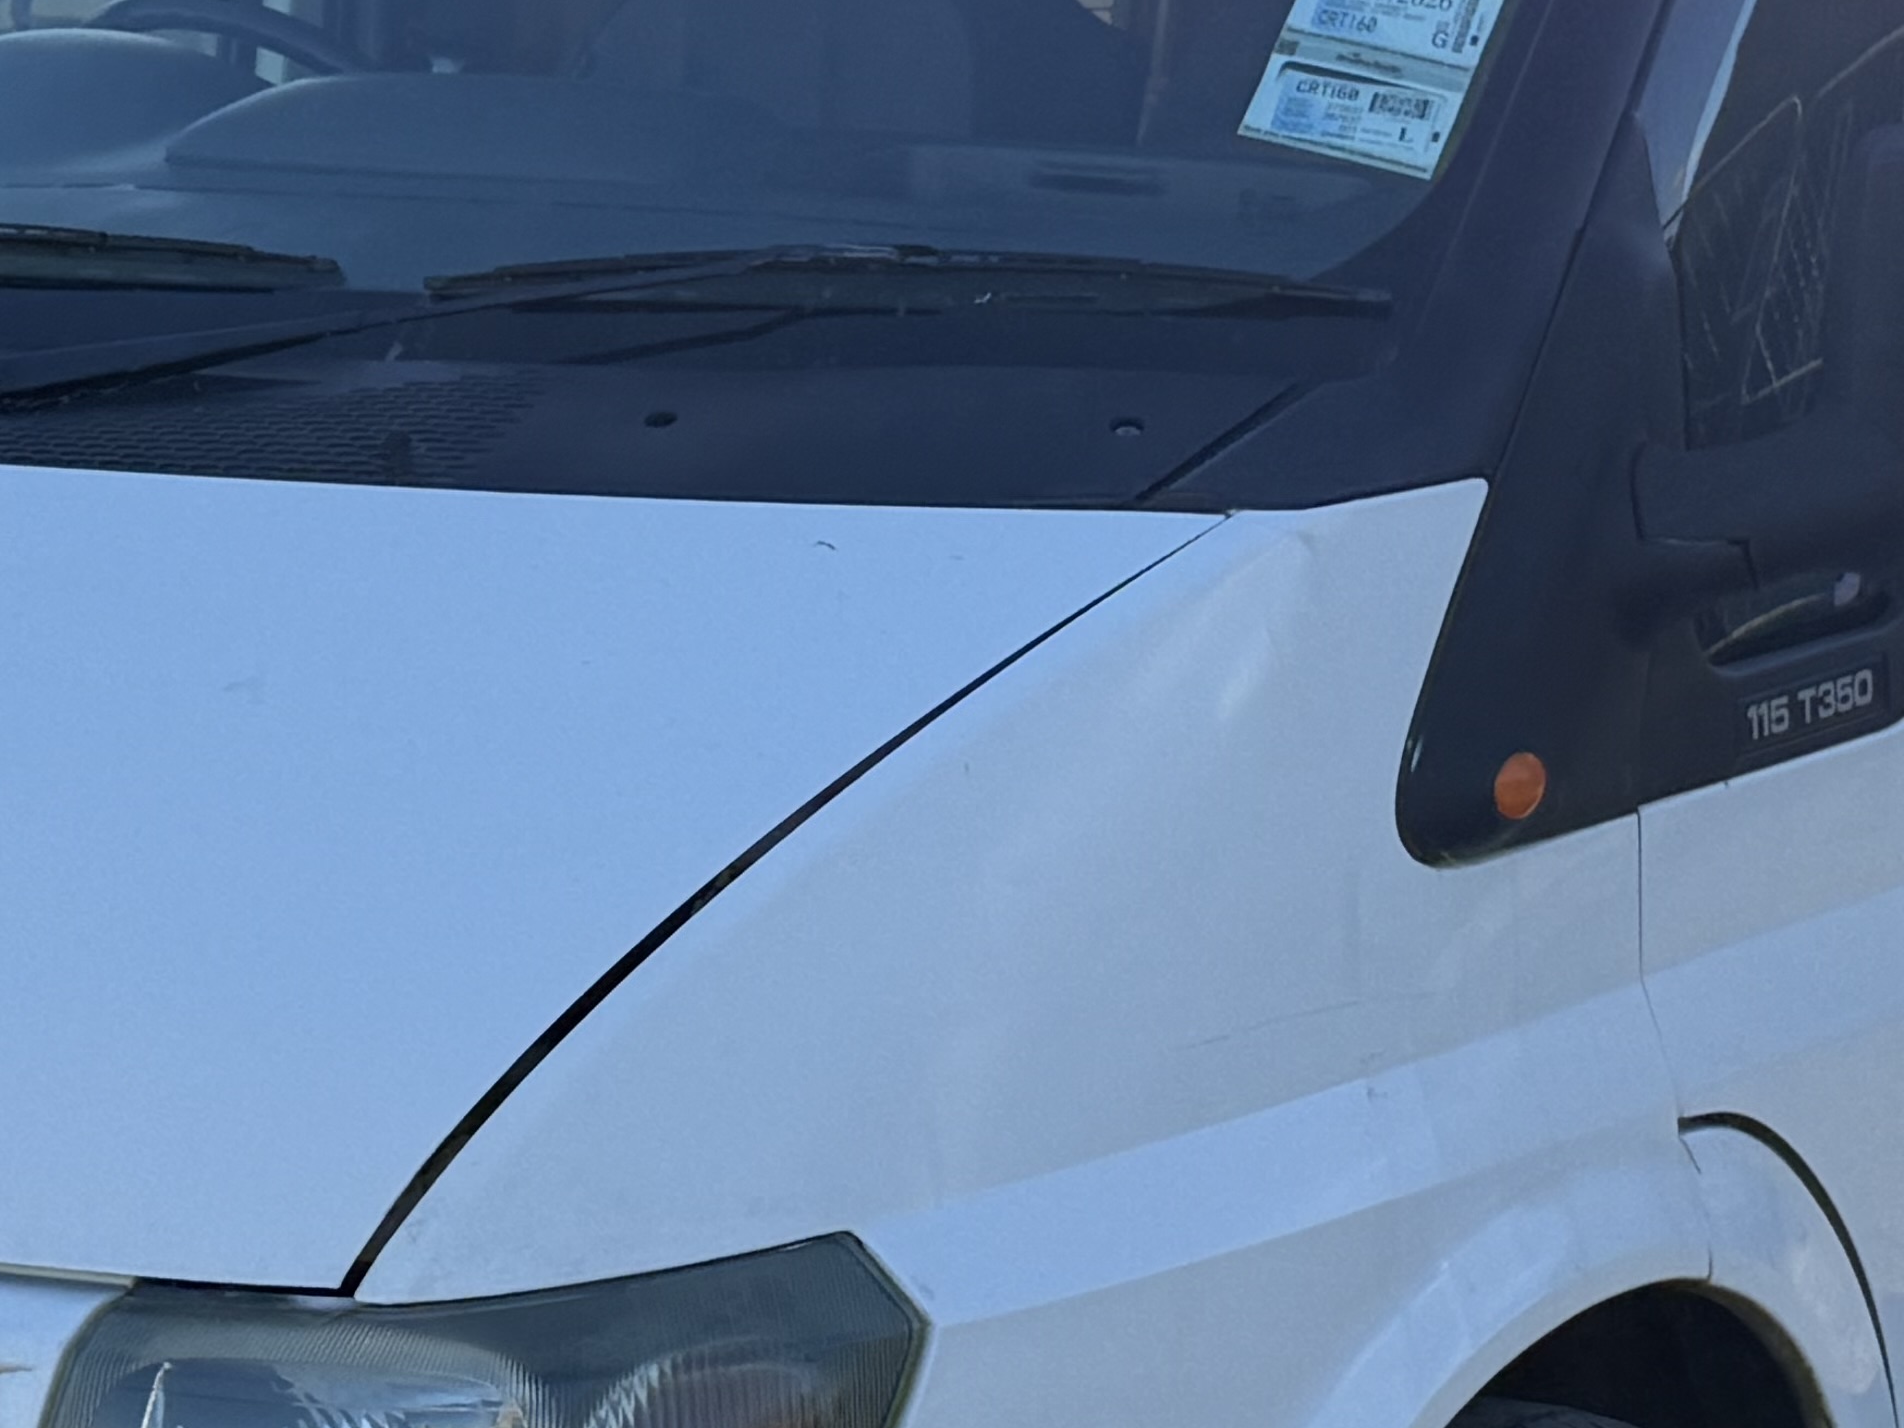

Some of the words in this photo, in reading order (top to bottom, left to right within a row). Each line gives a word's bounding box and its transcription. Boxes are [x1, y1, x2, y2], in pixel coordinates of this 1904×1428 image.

[1317, 8, 1378, 33] CRT160
[1296, 79, 1360, 101] CRT160
[1746, 696, 1791, 740] 115
[1797, 668, 1874, 726] T350
